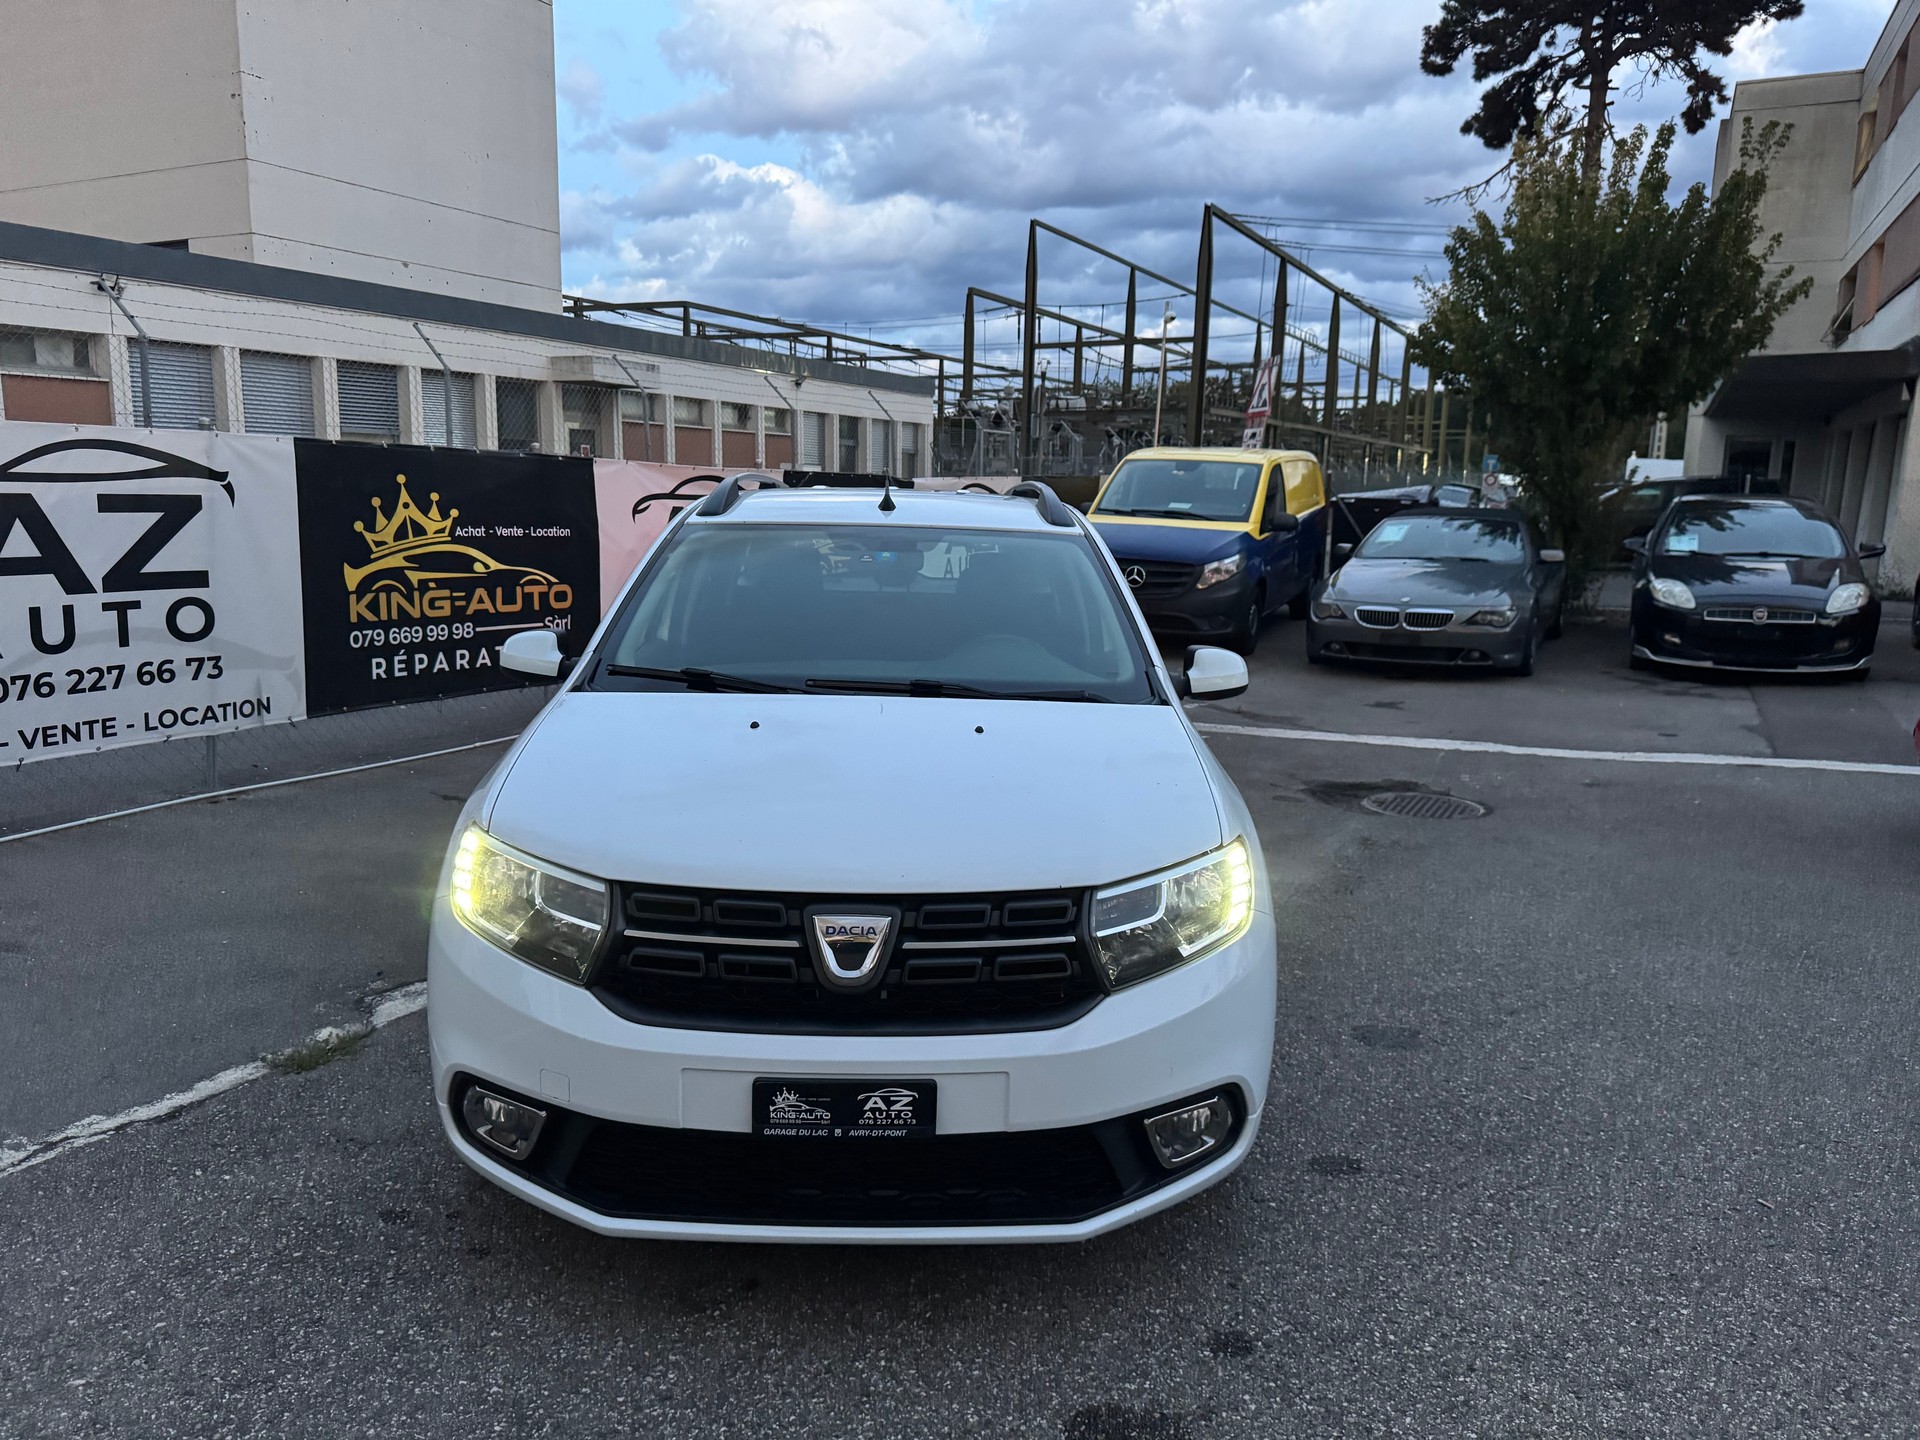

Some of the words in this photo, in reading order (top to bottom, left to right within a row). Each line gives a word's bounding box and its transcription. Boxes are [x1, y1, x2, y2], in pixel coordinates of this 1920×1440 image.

[455, 525, 486, 537] Achat
[495, 525, 524, 537] Vente
[530, 526, 571, 537] Location
[0, 492, 210, 596] AZ
[349, 584, 573, 623] KING-AUTO
[0, 596, 216, 659] UTO
[544, 614, 571, 630] Sàrl
[349, 628, 386, 649] 079
[388, 625, 423, 645] 669
[426, 624, 449, 642] 99
[452, 622, 474, 640] 98
[371, 645, 504, 680] RÉPARA
[65, 664, 126, 695] 227
[136, 659, 176, 686] 66
[185, 655, 223, 681] 73
[17, 716, 118, 750] VENTE
[143, 696, 271, 732] LOCATION
[825, 926, 877, 936] DACIA
[863, 1096, 913, 1110] AZ
[863, 1111, 912, 1119] AUTO
[763, 1128, 798, 1136] GARAGE
[798, 1128, 811, 1136] DU
[812, 1128, 829, 1136] LAC
[848, 1129, 908, 1137] AVRY-DT-PONT
